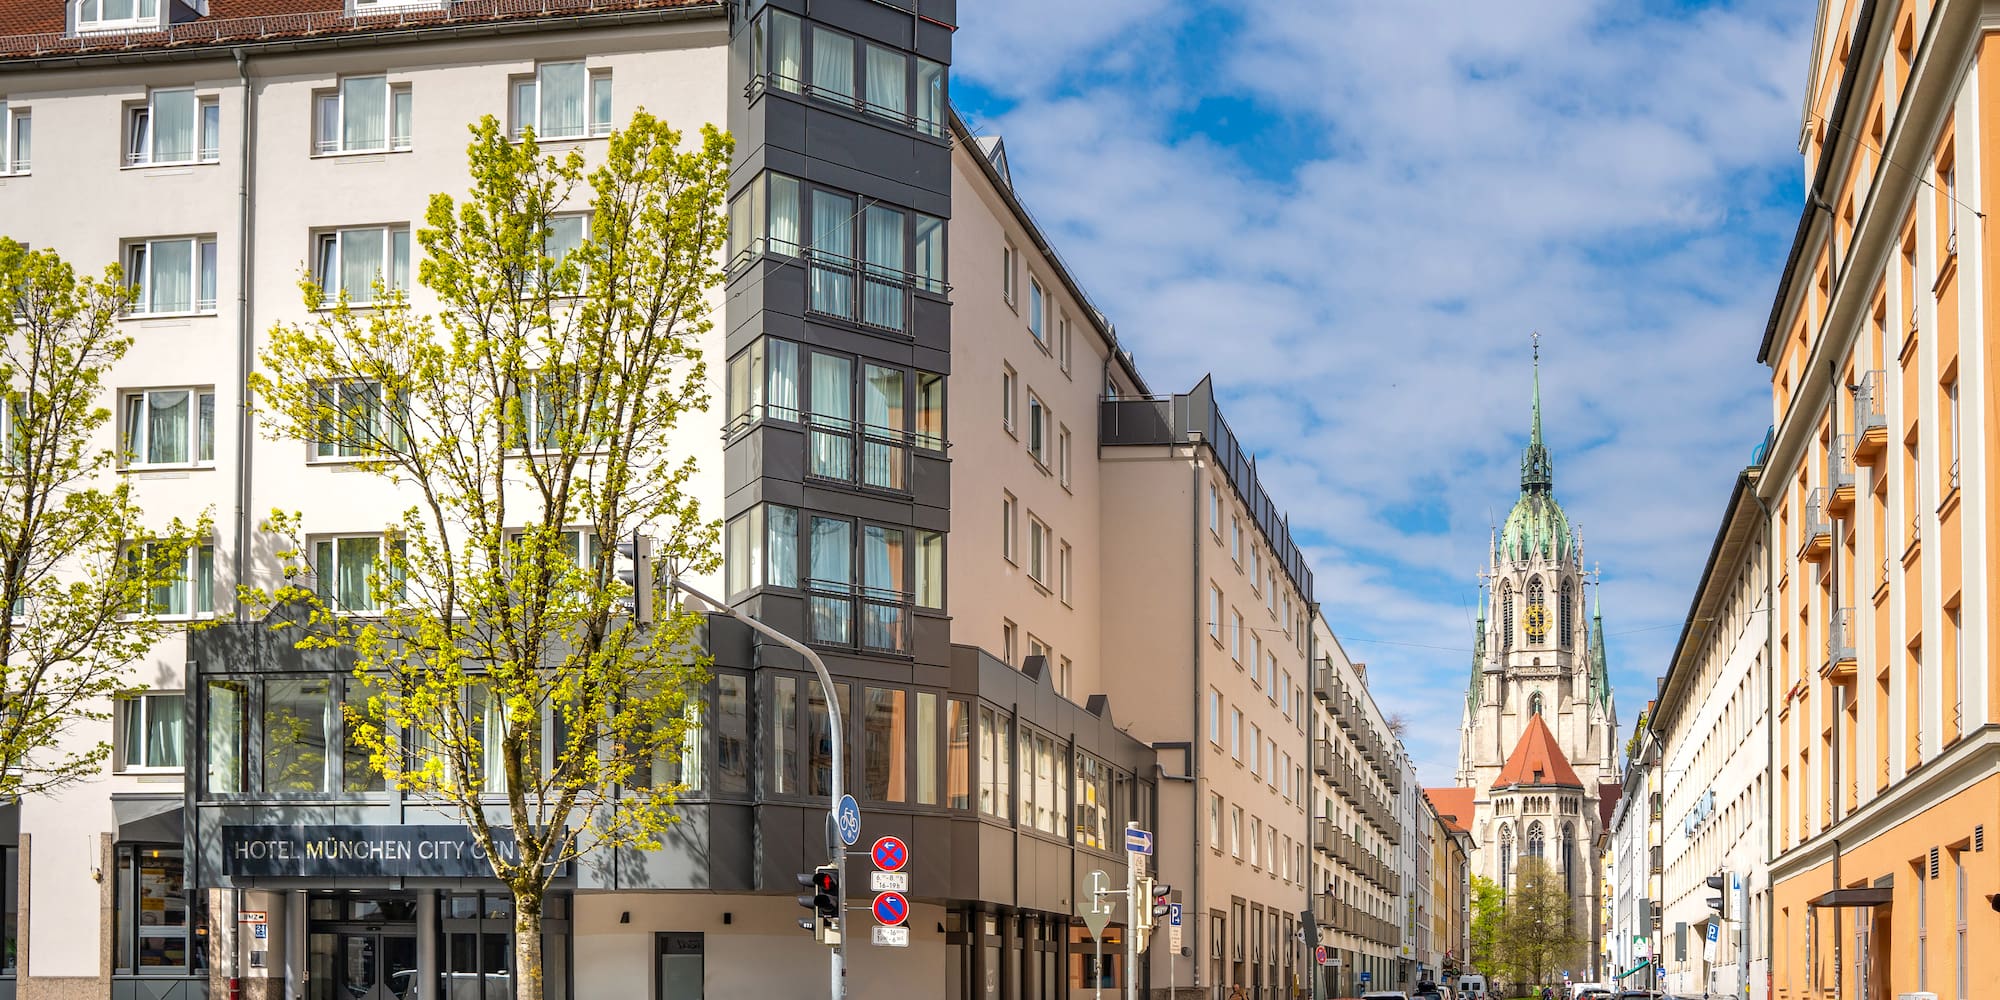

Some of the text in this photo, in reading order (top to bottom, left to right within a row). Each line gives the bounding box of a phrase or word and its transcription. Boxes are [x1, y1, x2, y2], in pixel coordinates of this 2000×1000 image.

[235, 840, 300, 860] HOTEL
[306, 837, 411, 860] MÜNCHEN
[418, 840, 465, 860] CITY
[1172, 906, 1179, 923] P
